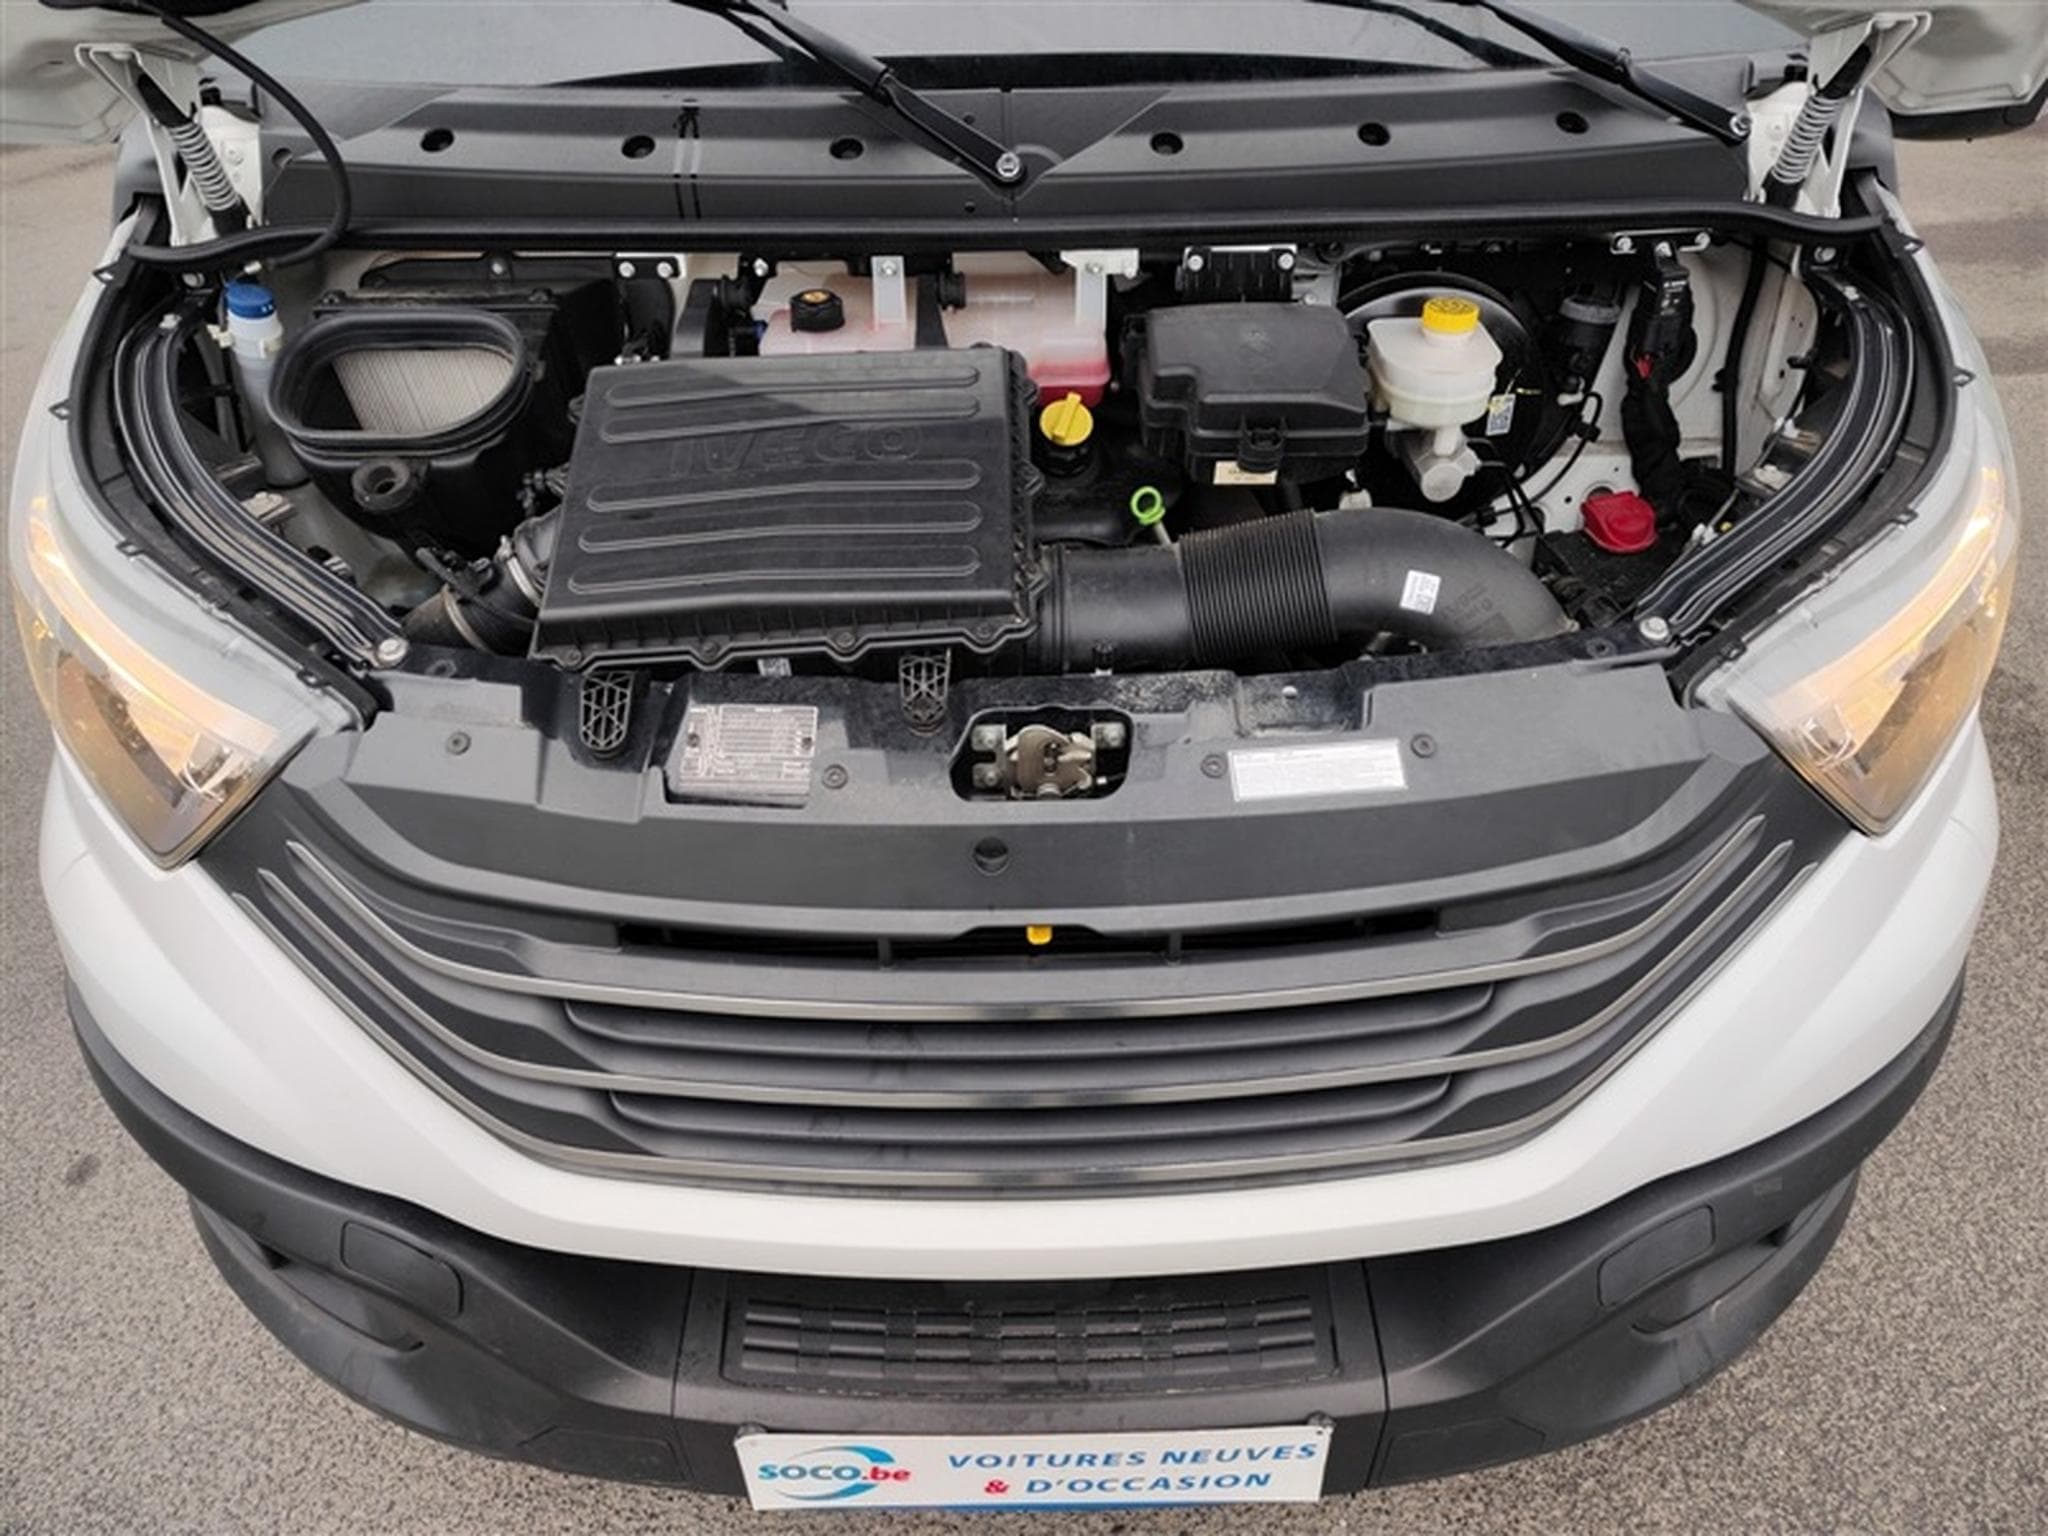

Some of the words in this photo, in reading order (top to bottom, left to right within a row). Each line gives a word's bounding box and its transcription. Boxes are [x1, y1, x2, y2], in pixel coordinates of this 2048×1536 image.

[669, 423, 923, 475] IVECO
[949, 1451, 1147, 1469] VOITURES
[1160, 1443, 1318, 1465] NEUVES
[984, 1479, 1009, 1495] &
[1025, 1472, 1272, 1494] D'OCCASION
